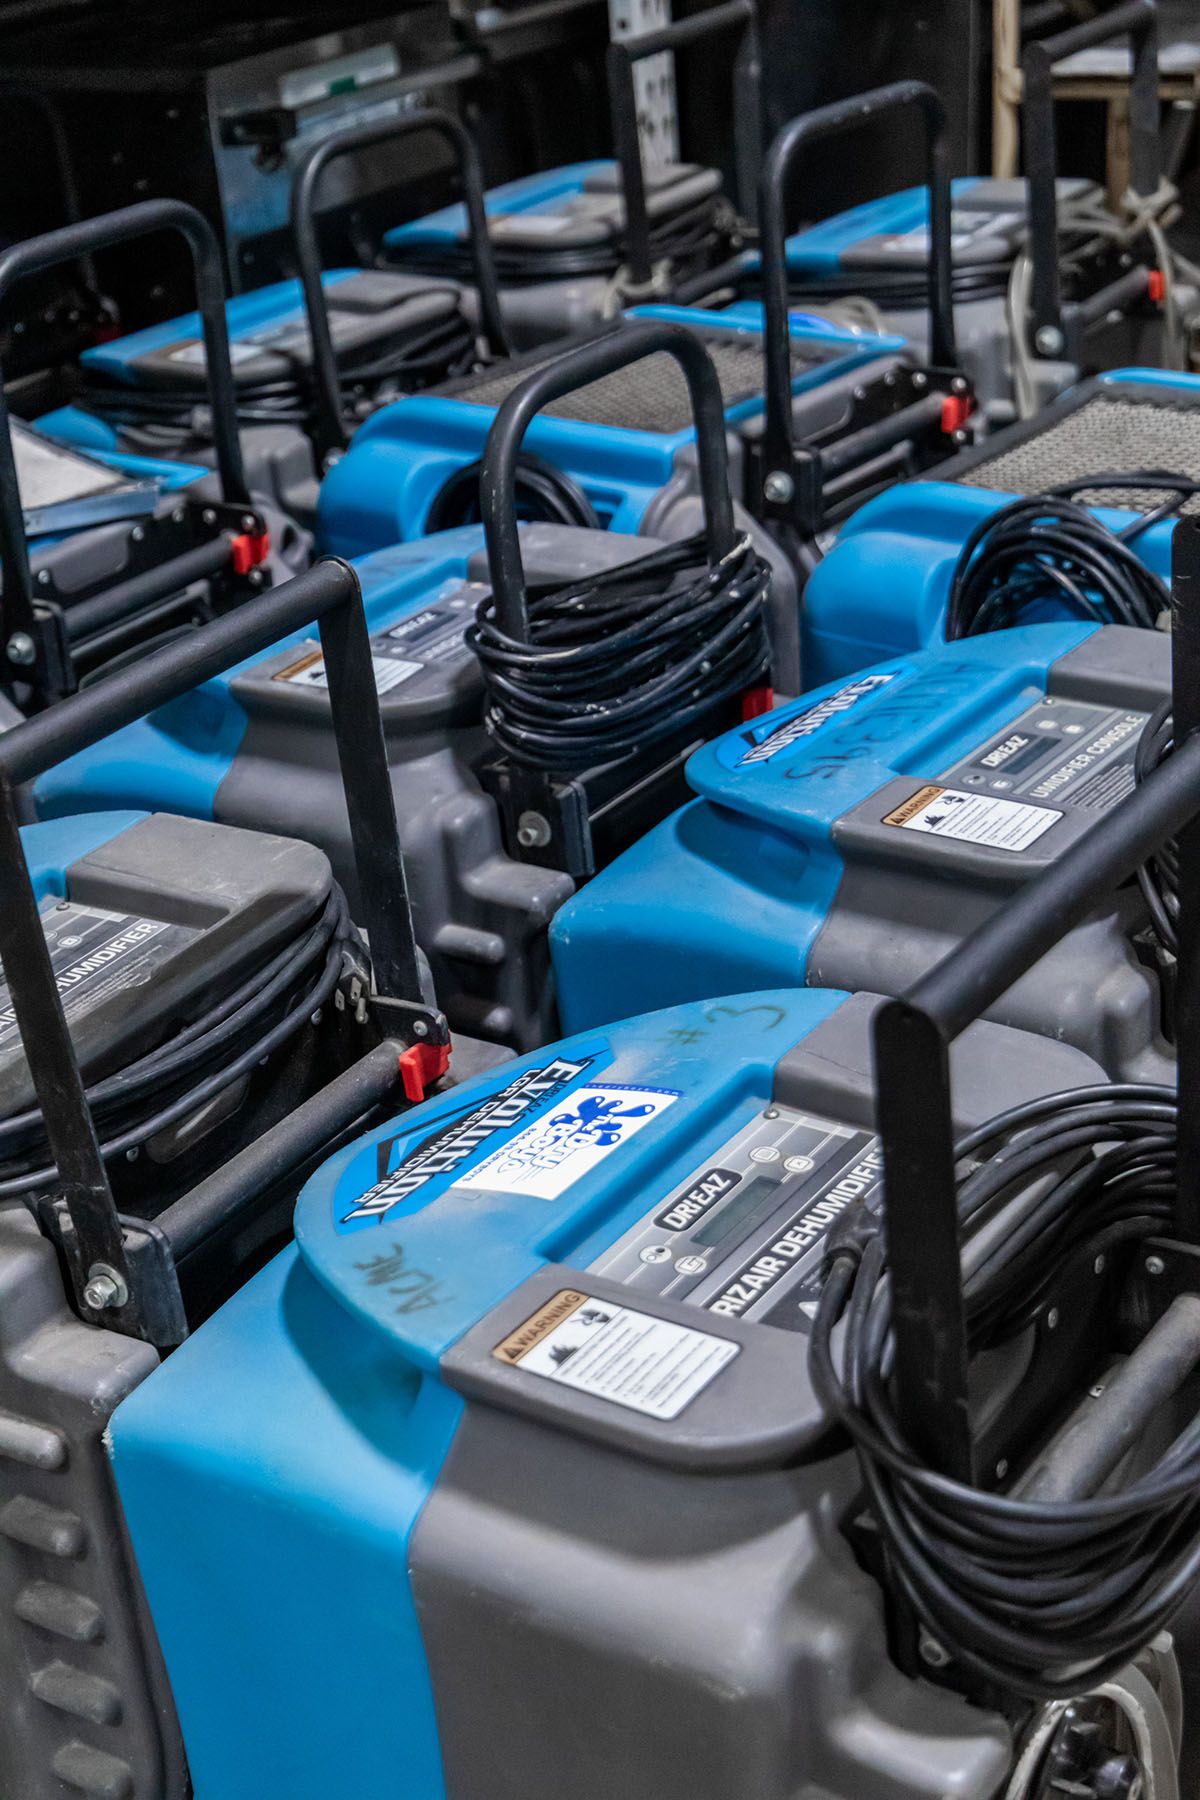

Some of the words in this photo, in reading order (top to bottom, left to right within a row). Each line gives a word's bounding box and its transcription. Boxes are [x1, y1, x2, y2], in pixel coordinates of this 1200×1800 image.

[734, 673, 895, 768] Evolution
[981, 735, 1029, 768] DRIEAZ
[1029, 753, 1095, 798] UMIDIFIER
[1086, 715, 1145, 756] CONSOLE
[895, 787, 940, 818] WARNING
[57, 922, 158, 991] HUMIDIFIER
[498, 1069, 542, 1097] LGR
[340, 1056, 594, 1223] Evolution
[352, 1098, 498, 1203] DEHUMIDIFIER
[497, 1119, 583, 1173] Boys
[530, 1129, 603, 1169] Dry
[582, 1113, 614, 1132] The
[662, 1172, 731, 1229] DRIEAZ
[709, 1255, 788, 1318] RIZAIR
[770, 1146, 884, 1259] DEHUMIDIFIE
[517, 1292, 581, 1348] WARNING
